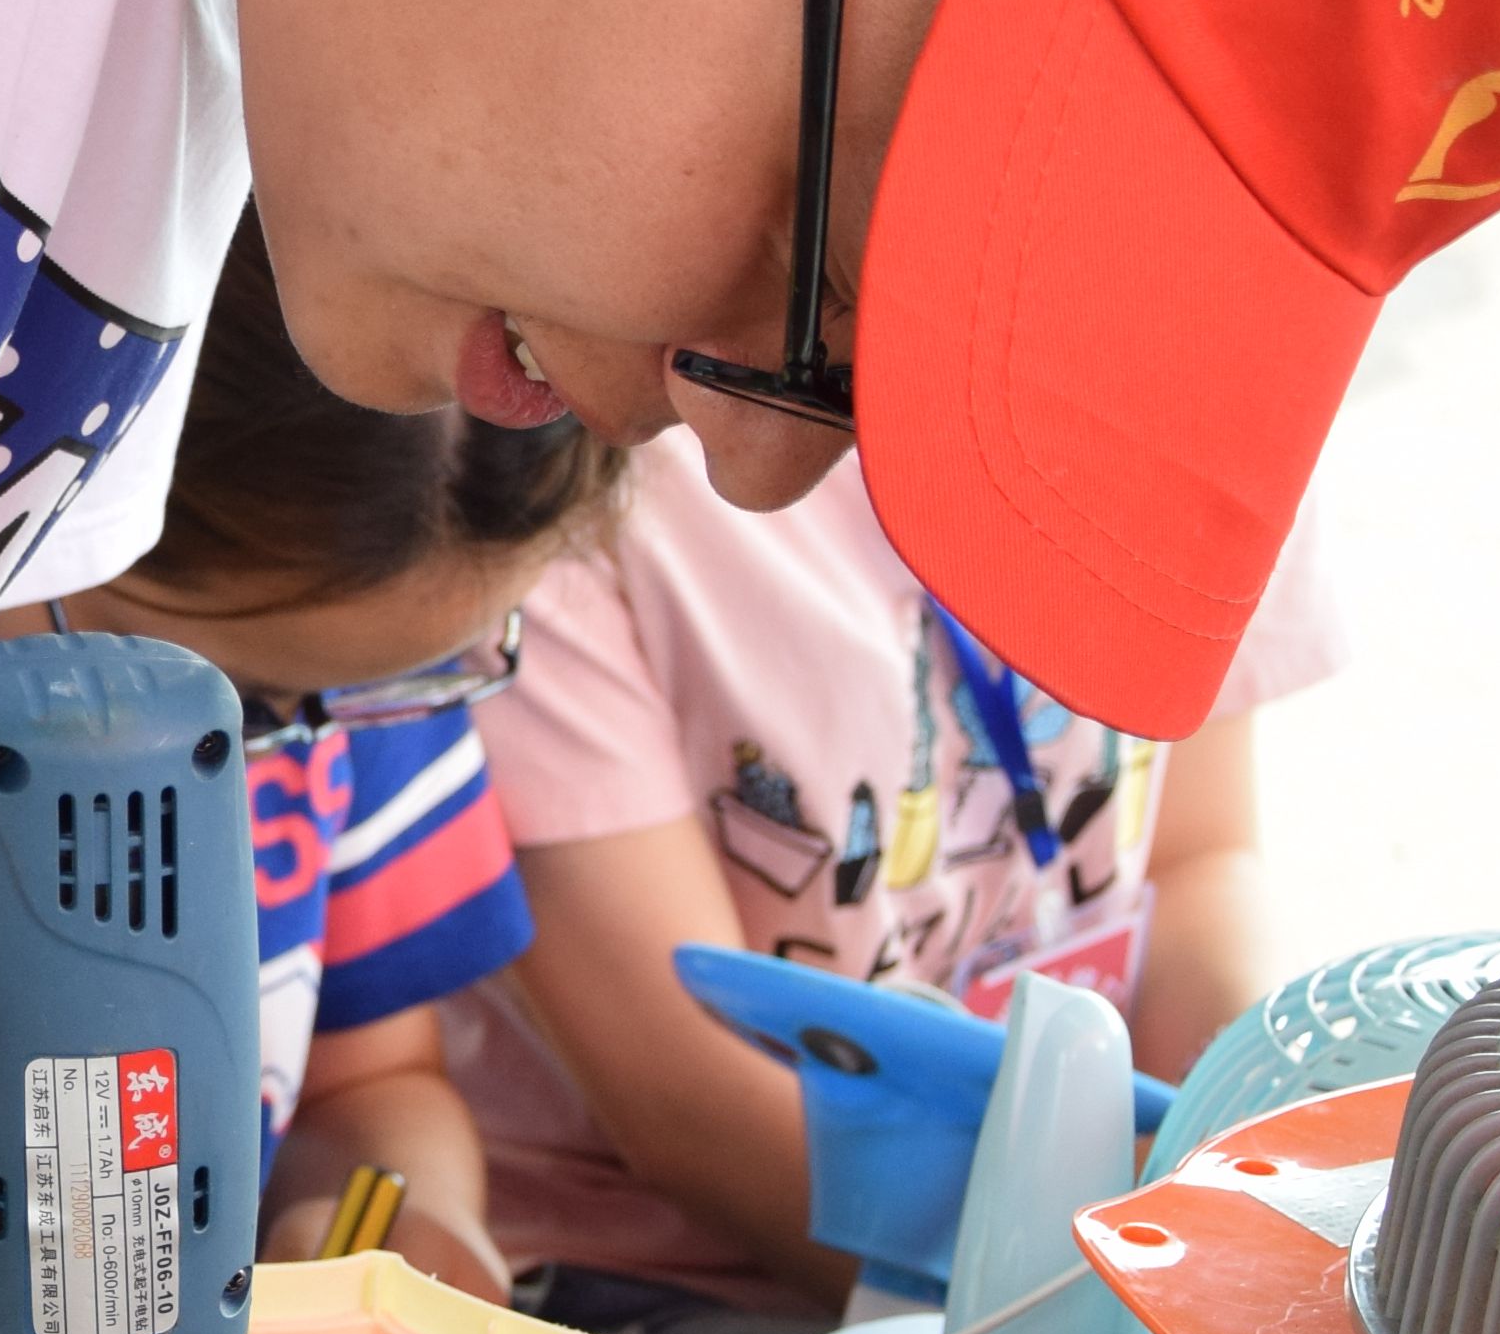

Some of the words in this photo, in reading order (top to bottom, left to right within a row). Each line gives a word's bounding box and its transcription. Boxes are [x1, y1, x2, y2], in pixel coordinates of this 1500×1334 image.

[32, 1069, 50, 1139] 江苏启东
[62, 1068, 78, 1095] No.
[96, 1071, 110, 1099] 12V
[98, 1135, 114, 1179] 1.7Ah
[36, 1154, 59, 1334] 江苏东成工具有限公司
[102, 1245, 120, 1327] 0-600r/min
[132, 1235, 148, 1331] 充电式起子电钻
